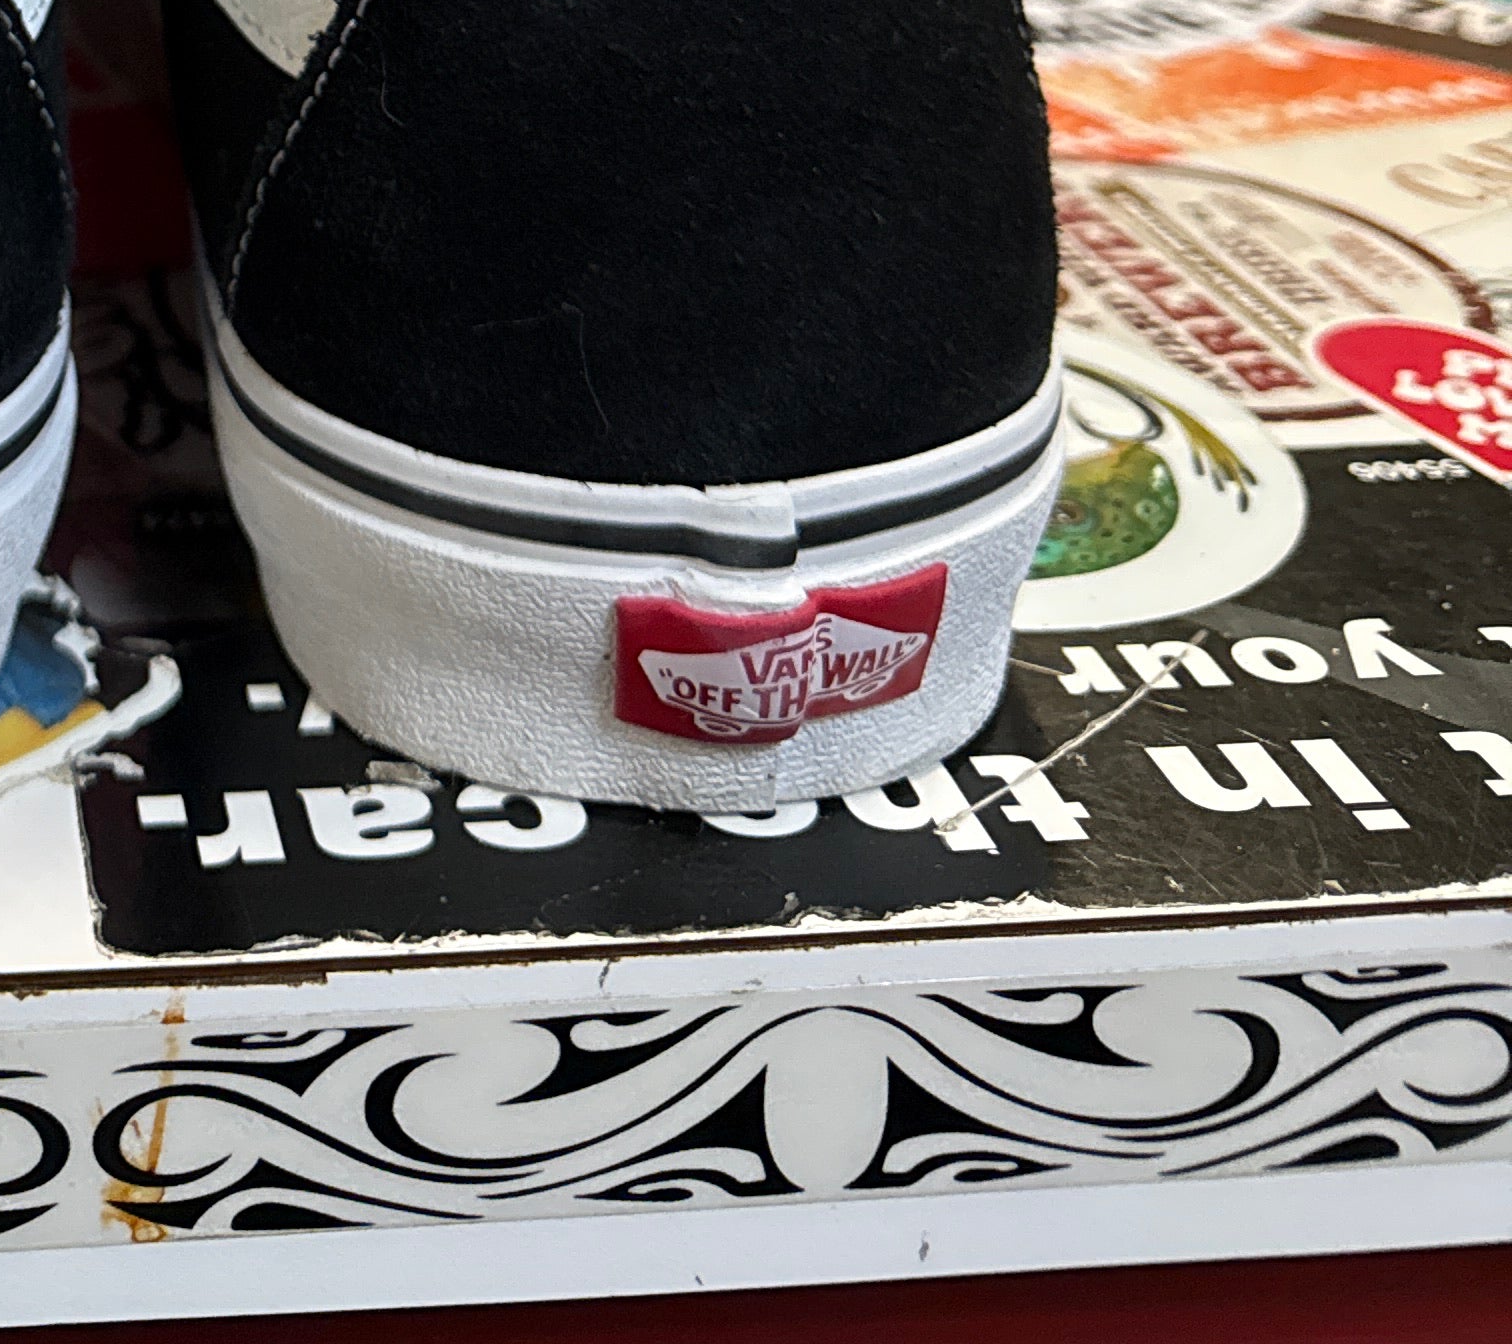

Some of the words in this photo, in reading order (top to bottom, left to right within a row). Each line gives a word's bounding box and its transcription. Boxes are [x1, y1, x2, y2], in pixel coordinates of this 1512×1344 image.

[1057, 617, 1444, 696] your
[751, 677, 813, 720] TH
[1143, 737, 1411, 831] in
[136, 783, 588, 869] car.
